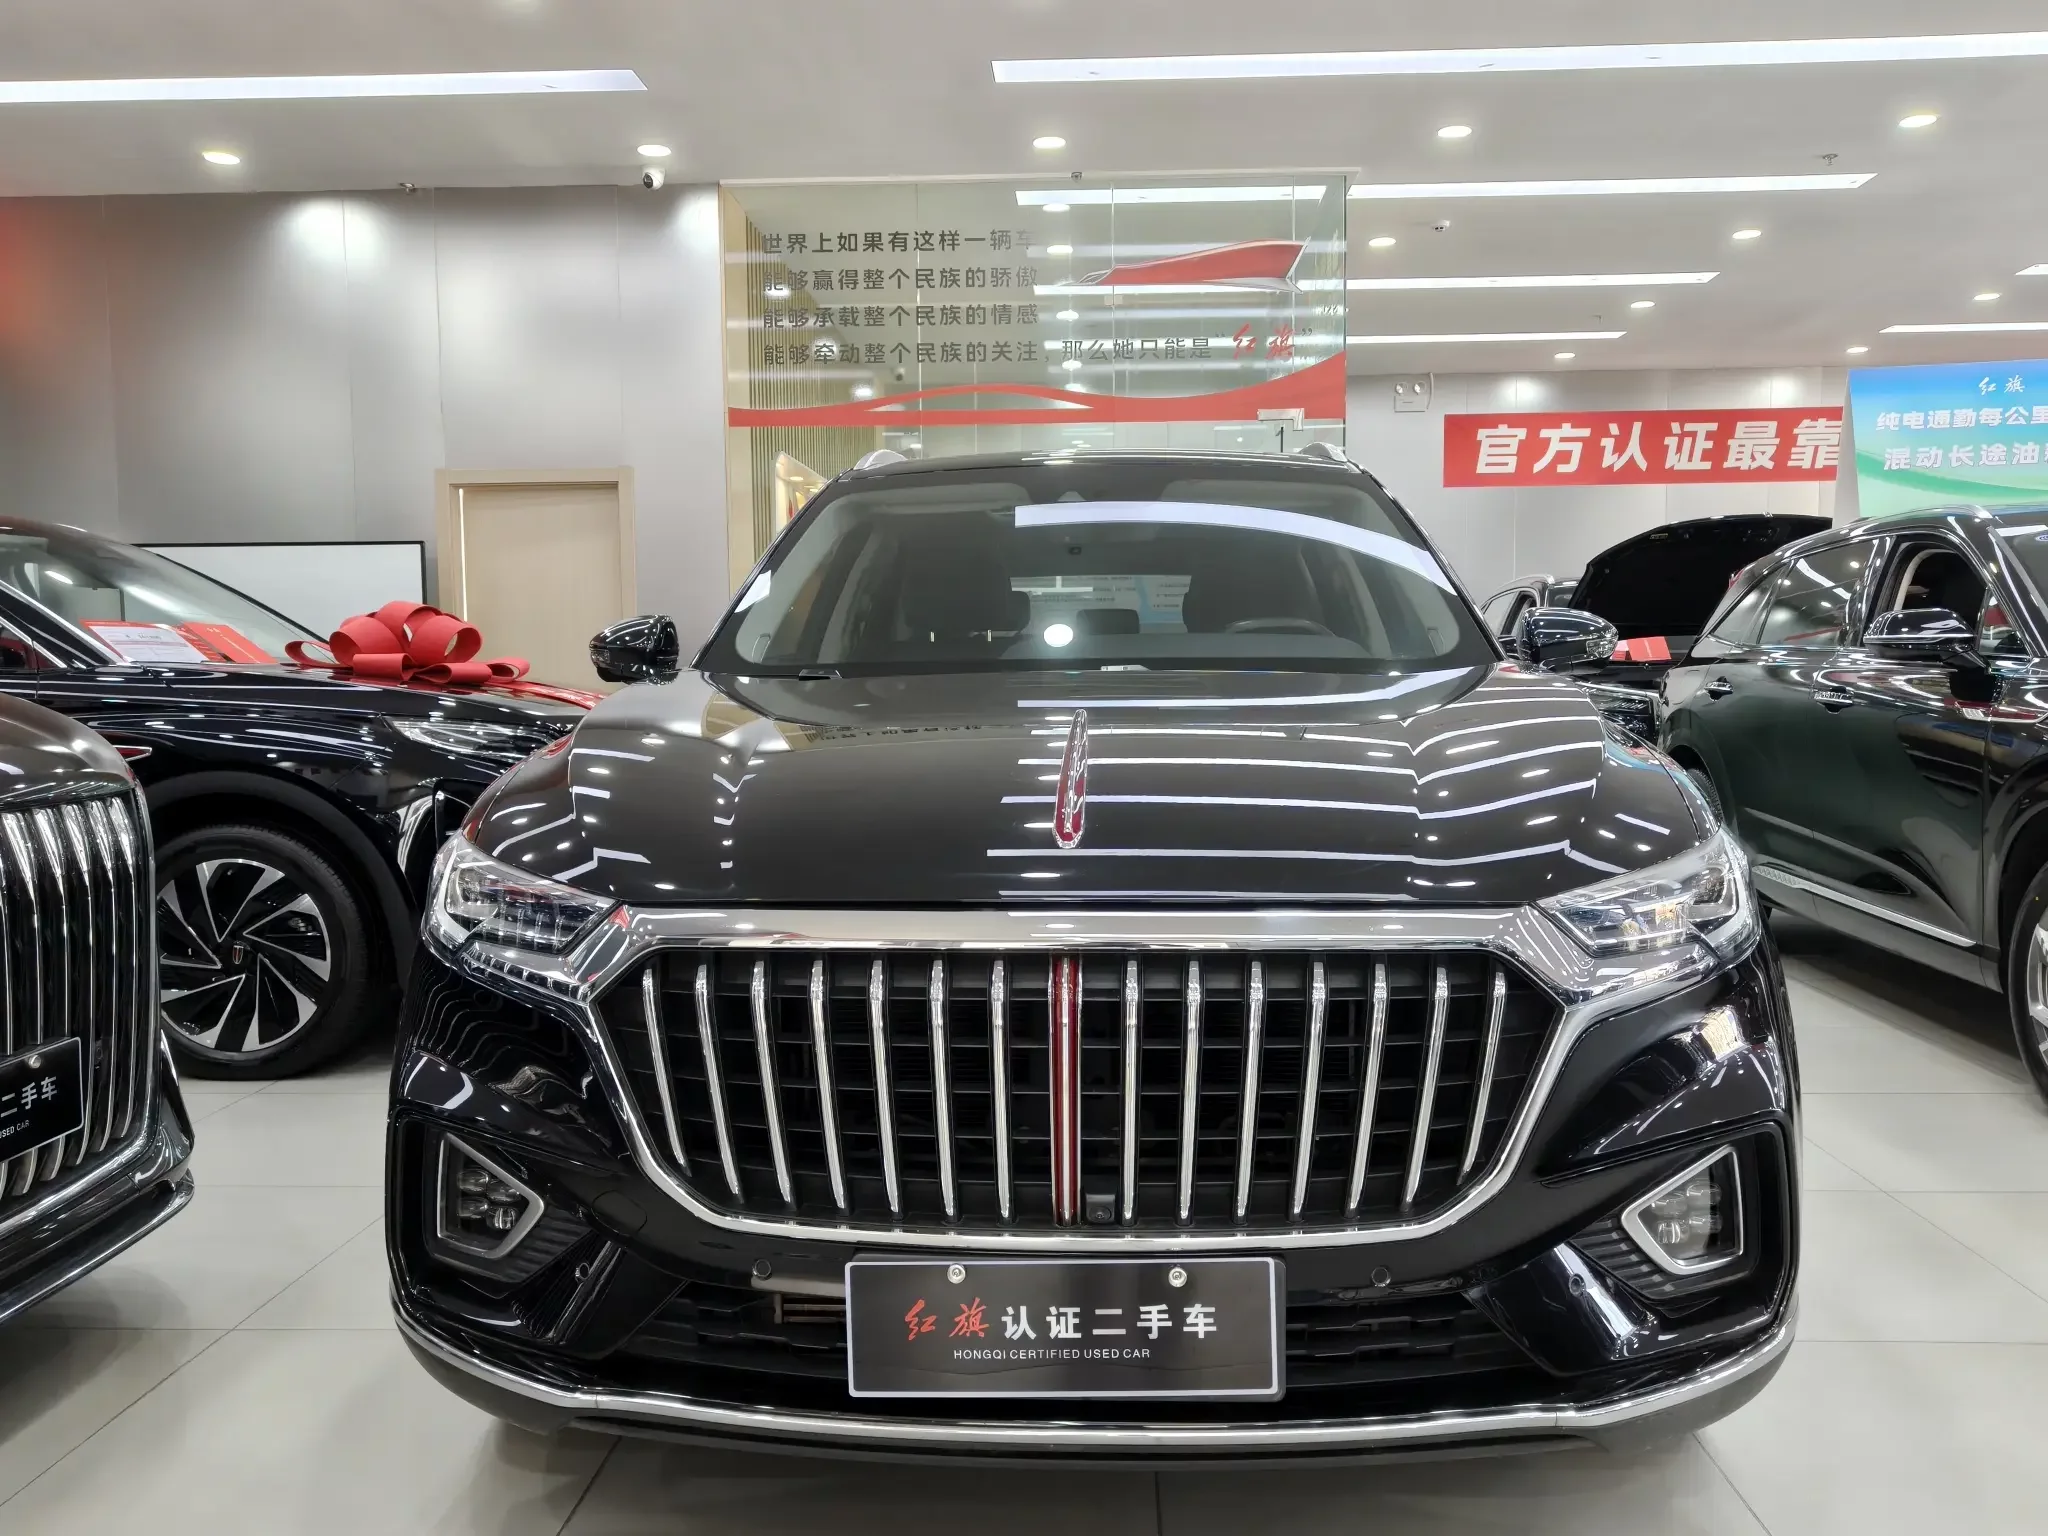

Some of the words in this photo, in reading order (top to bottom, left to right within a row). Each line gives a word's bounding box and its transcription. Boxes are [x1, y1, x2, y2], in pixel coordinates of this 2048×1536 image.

[763, 229, 1037, 254] 世界上如果有这样一辆车
[763, 266, 1038, 292] 能够赢得整个民族的骄傲
[763, 303, 1039, 329] 能够承载整个民族的情感
[1979, 375, 2026, 396] 红旗
[1876, 405, 2048, 432] 纯电通勤每公里
[1475, 418, 1843, 474] 官方认证最靠
[1883, 441, 2048, 471] 混动长途油
[0, 1076, 58, 1118] 二手车
[953, 1349, 1006, 1360] HONGQI
[1009, 1349, 1080, 1360] CERTIFIED
[1083, 1348, 1120, 1359] USED
[1123, 1348, 1150, 1359] CAR
